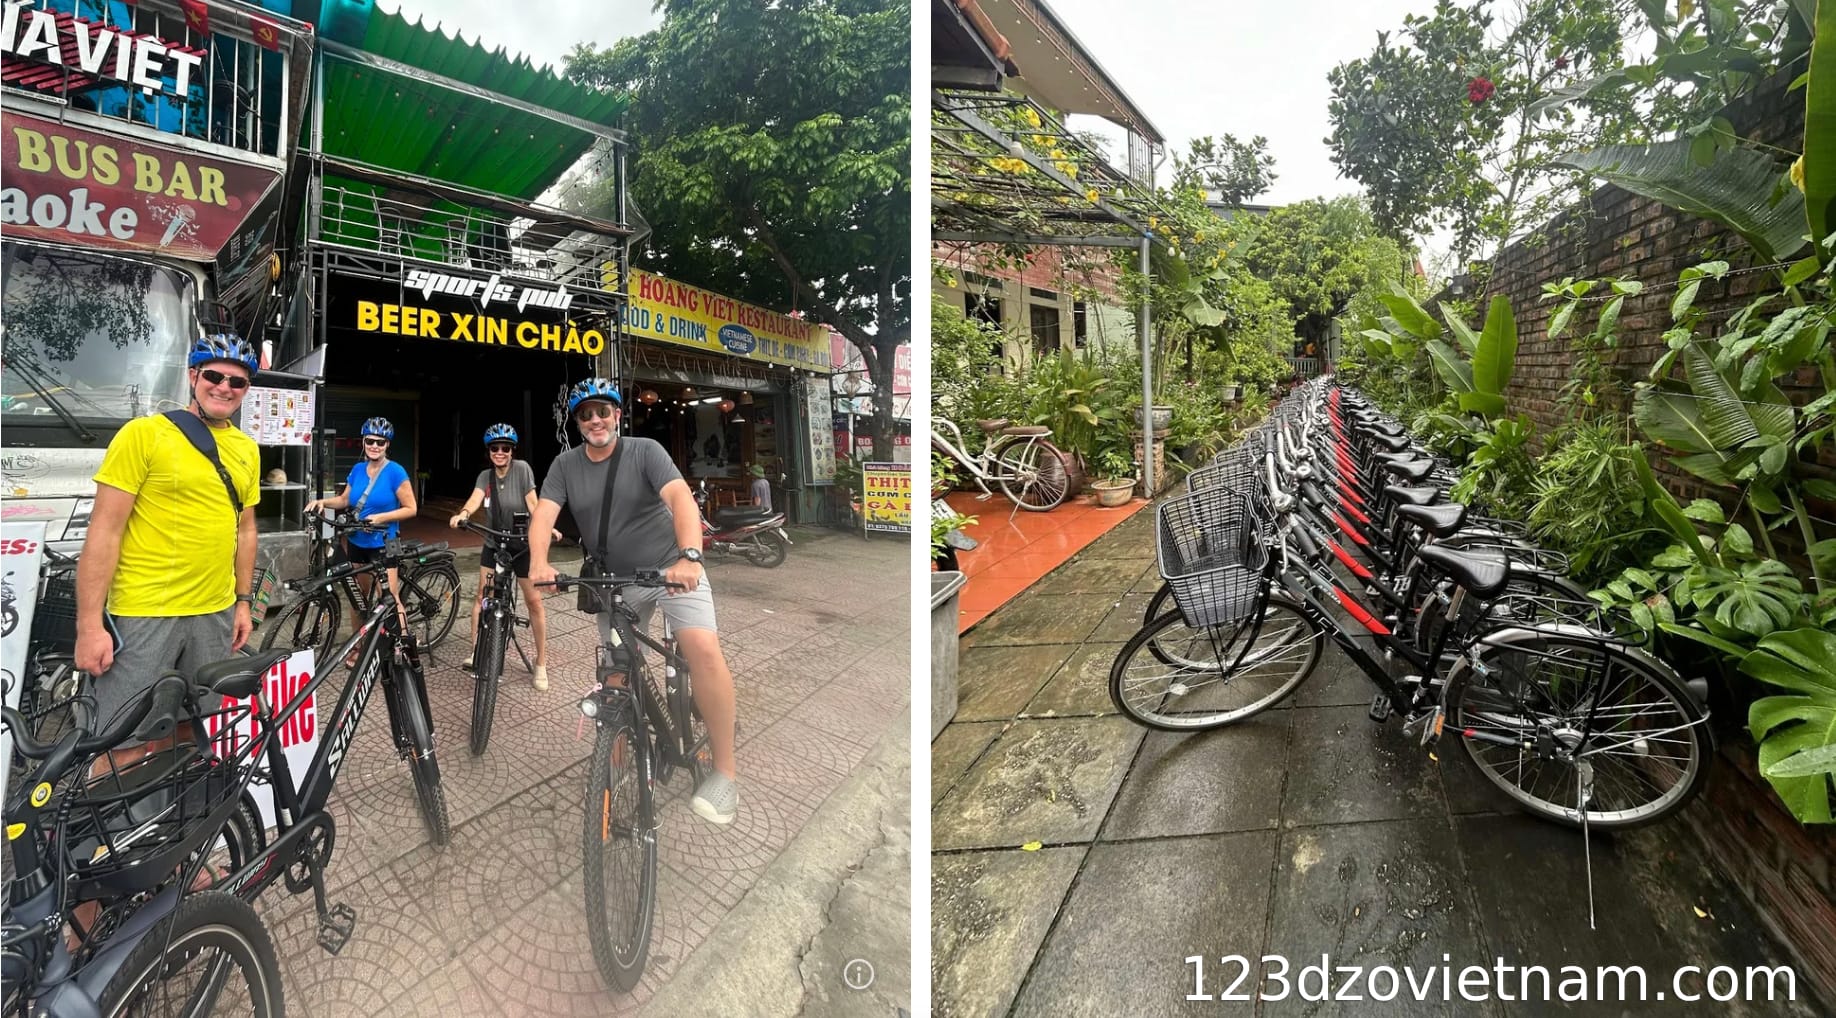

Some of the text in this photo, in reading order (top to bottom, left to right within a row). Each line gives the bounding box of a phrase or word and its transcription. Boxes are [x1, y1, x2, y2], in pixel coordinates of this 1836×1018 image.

[73, 20, 202, 97] VIỆT
[12, 126, 228, 206] BUS BAR
[404, 270, 574, 313] sports pub
[639, 272, 812, 342] HOANG VIET RESTAURANT
[357, 300, 605, 356] BEER XIN CHÀO
[670, 316, 707, 343] DRINK
[867, 476, 911, 491] THỊT
[345, 576, 367, 611] ALLWAY
[327, 648, 381, 780] SALLWAY
